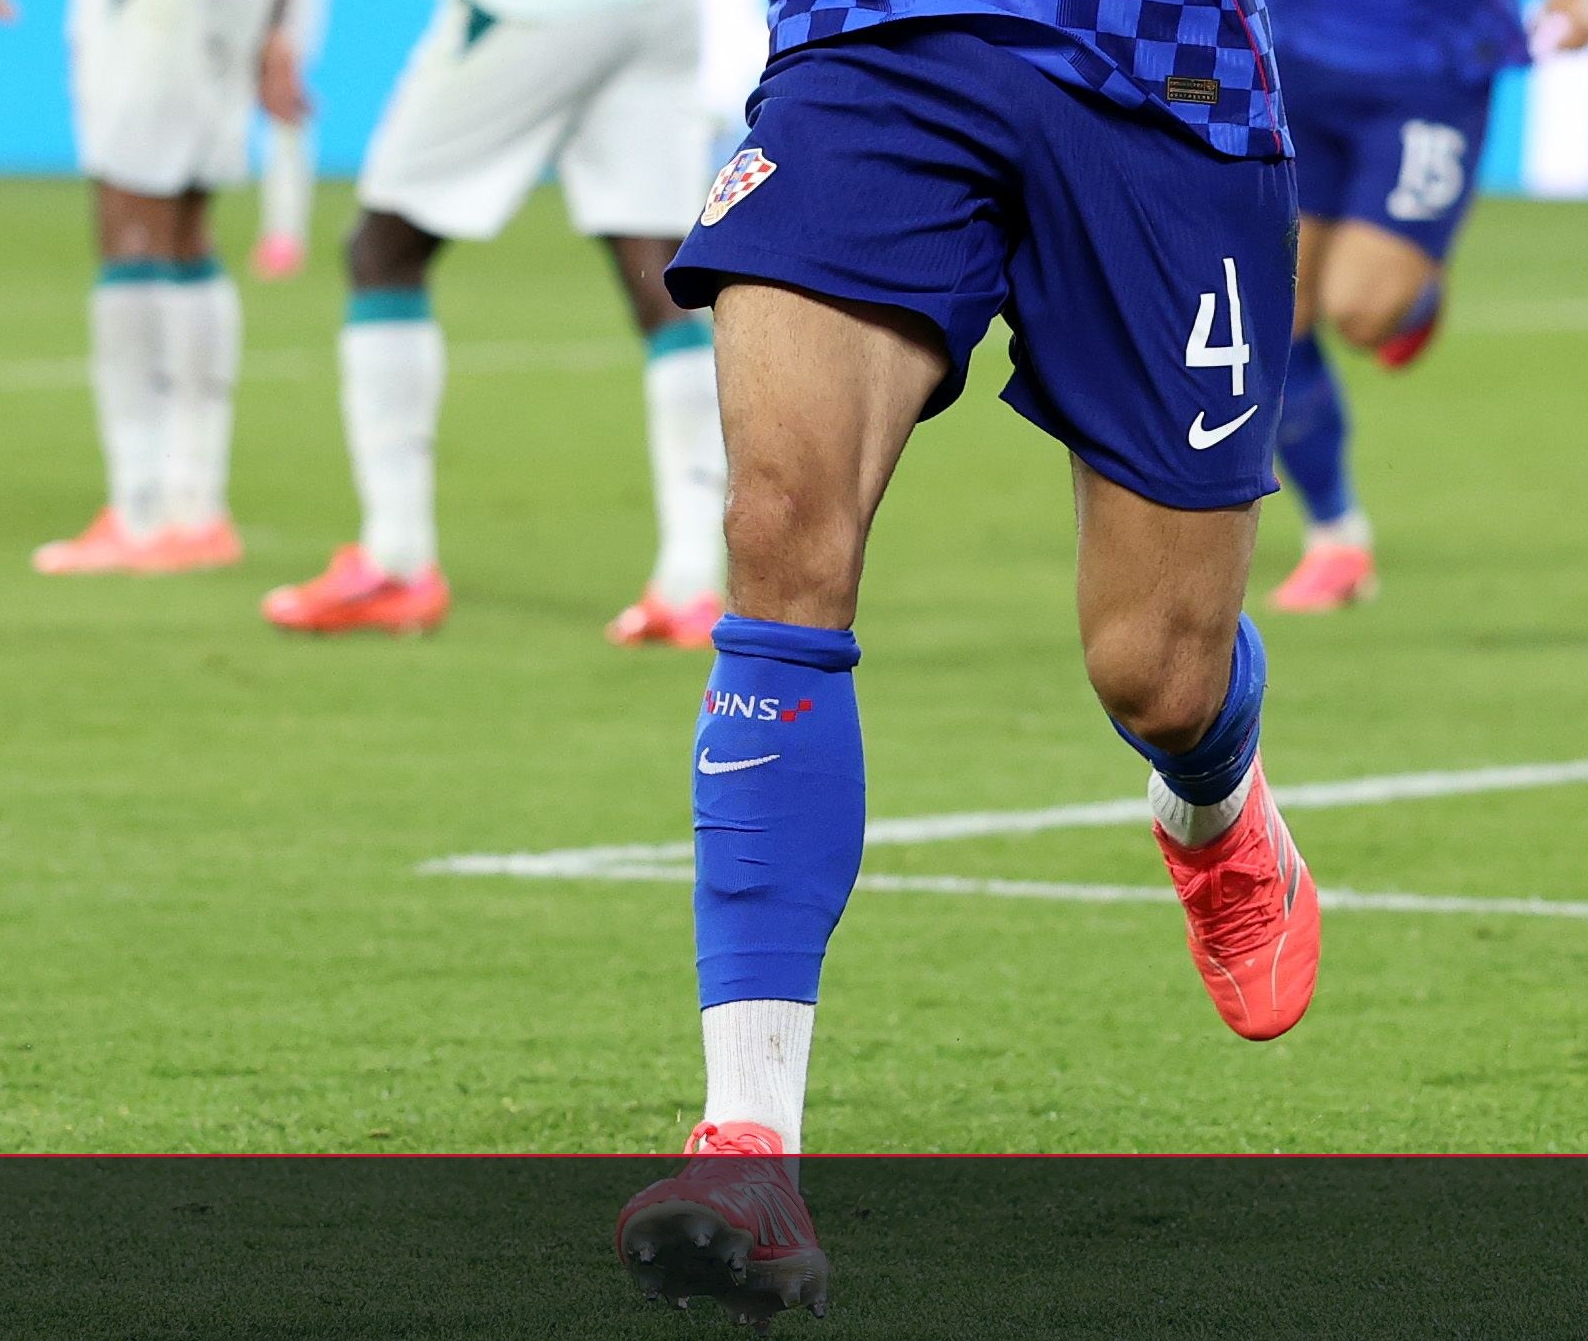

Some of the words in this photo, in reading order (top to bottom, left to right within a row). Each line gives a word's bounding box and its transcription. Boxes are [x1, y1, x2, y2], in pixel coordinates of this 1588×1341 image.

[1399, 120, 1467, 210] 15
[1186, 258, 1249, 396] 4
[713, 691, 779, 720] HNS
